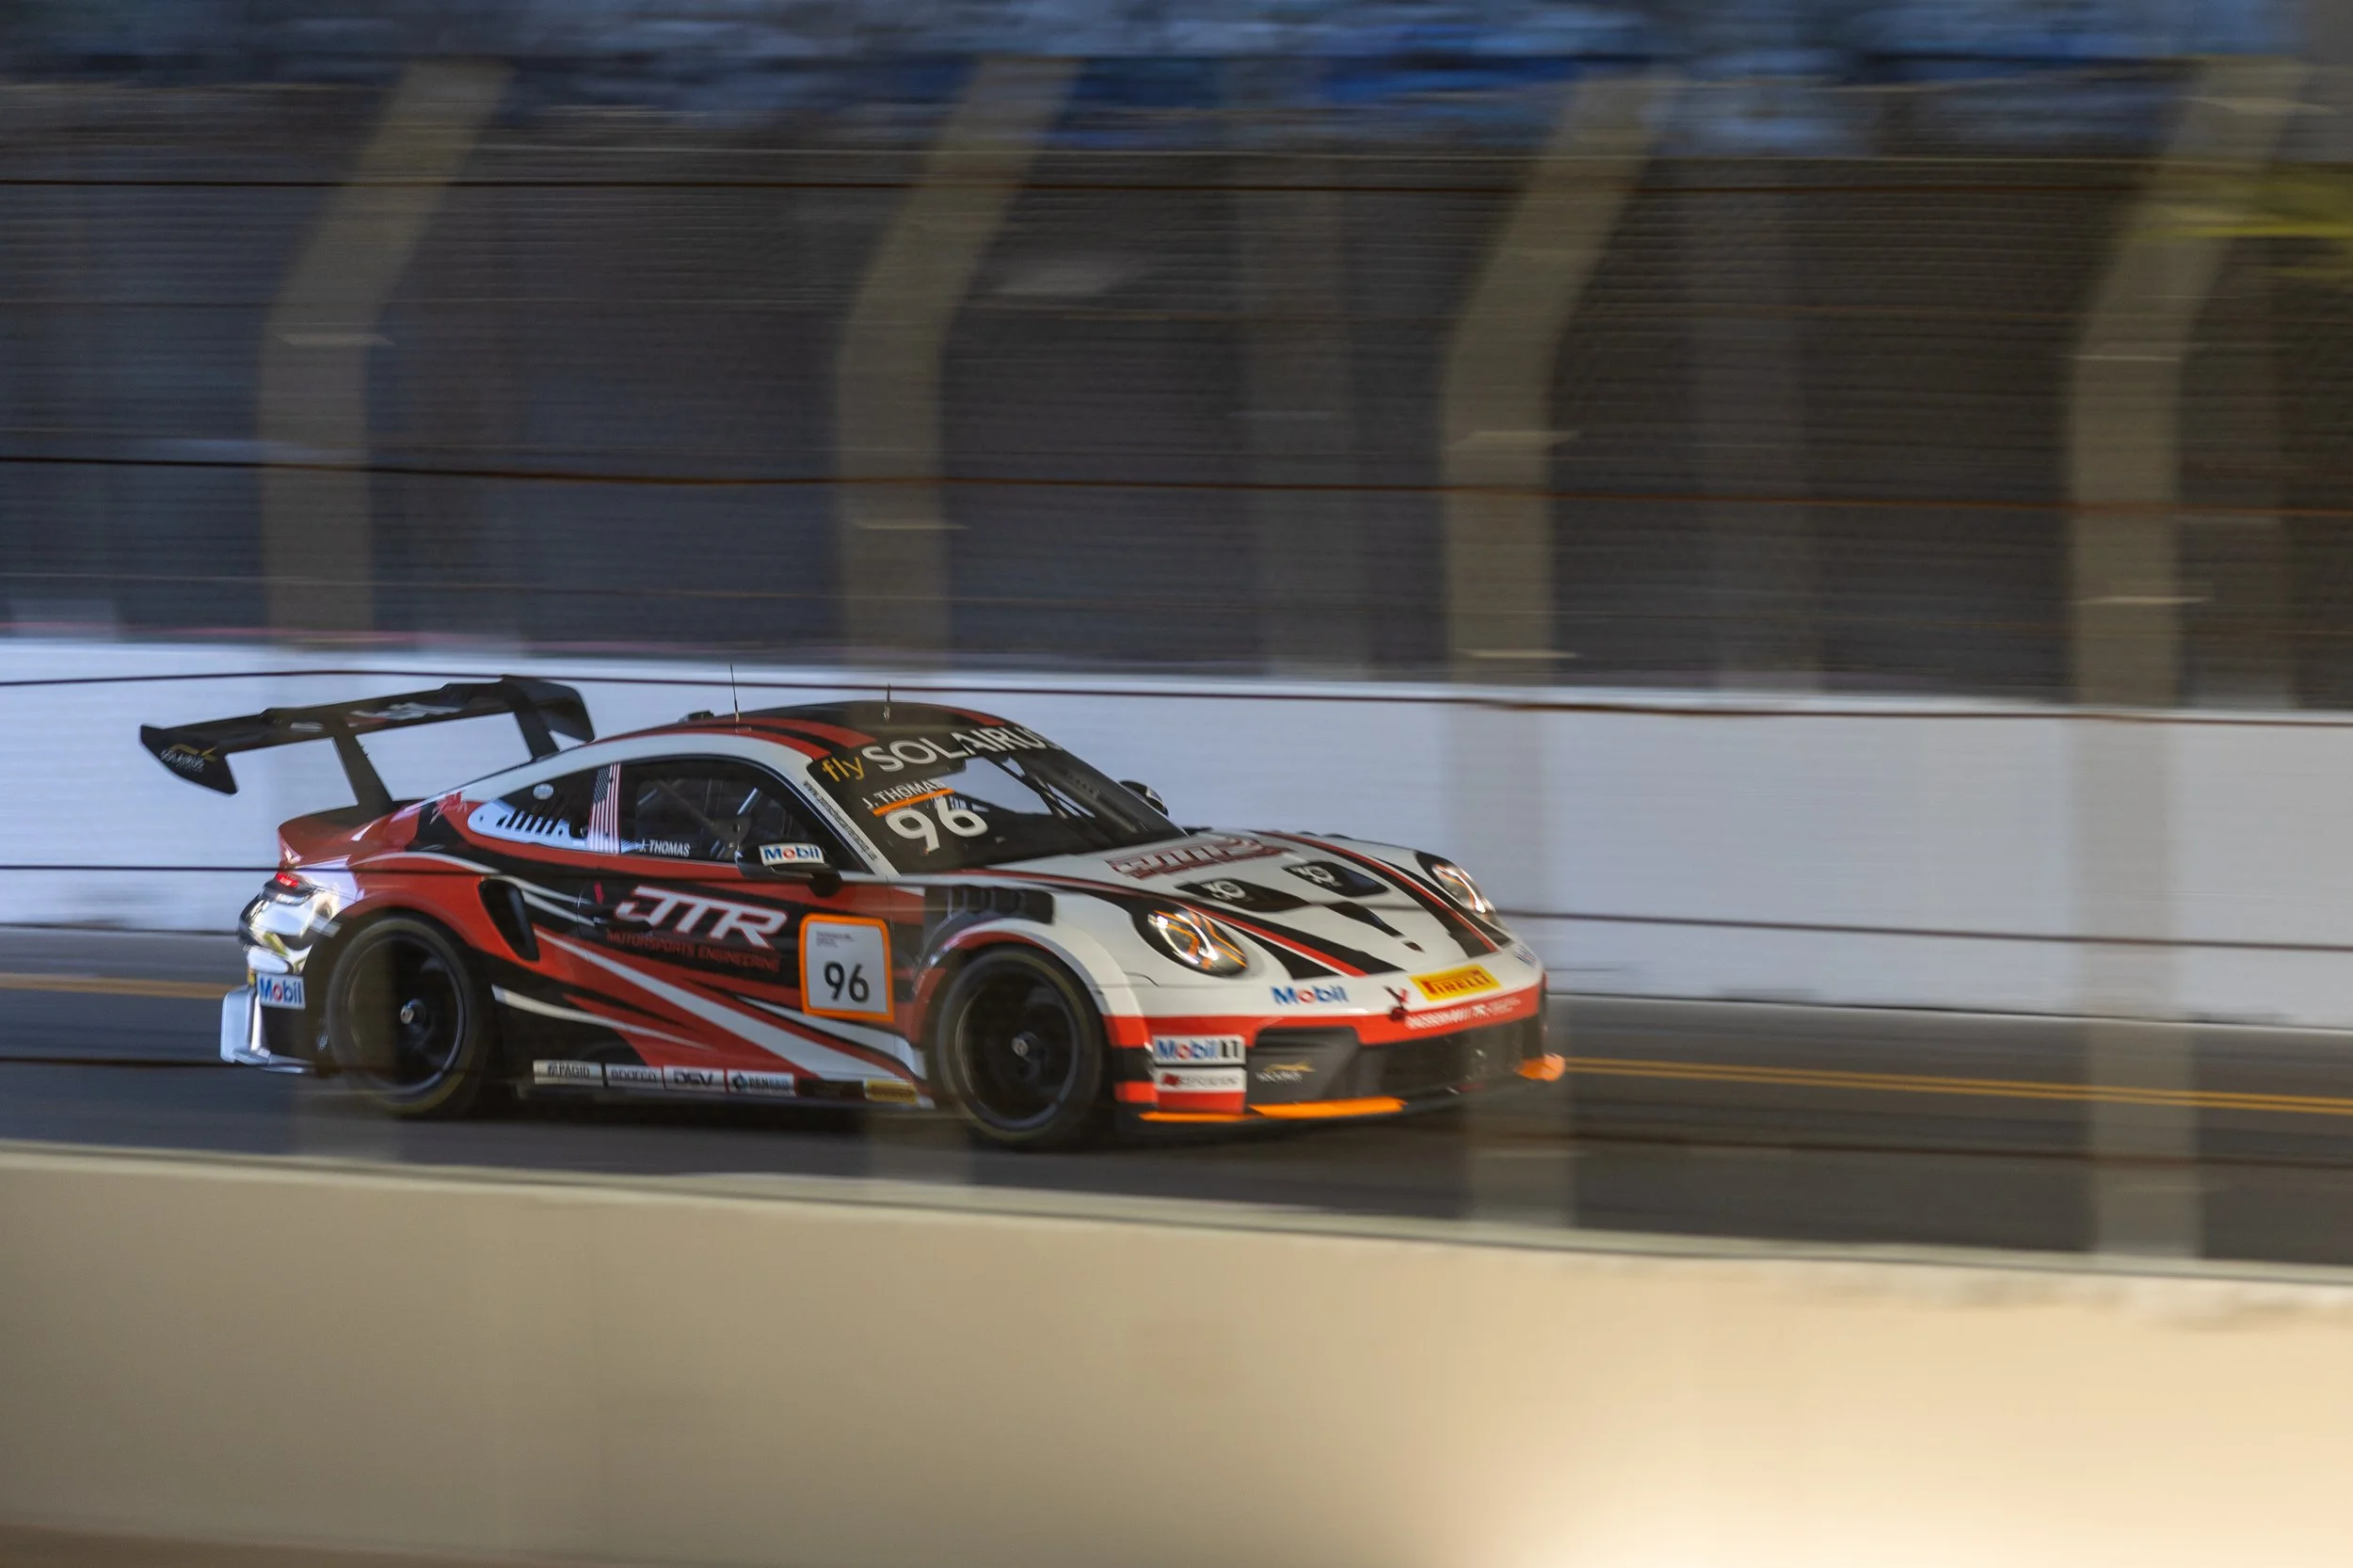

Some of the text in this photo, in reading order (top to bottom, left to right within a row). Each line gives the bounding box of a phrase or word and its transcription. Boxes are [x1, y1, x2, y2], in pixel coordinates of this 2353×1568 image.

[822, 756, 865, 783] fly
[885, 795, 989, 852] 96
[649, 839, 691, 857] THOMAS
[763, 846, 820, 861] Mobil
[616, 886, 788, 950] JTR
[606, 928, 696, 958] MOTORSPORTS
[698, 944, 781, 973] ENGINEERING
[260, 977, 302, 1004] Mobil
[824, 960, 870, 1003] 96
[1420, 968, 1493, 996] PIRELLI
[1270, 985, 1350, 1006] Mobil
[1157, 1039, 1217, 1060] Mobil
